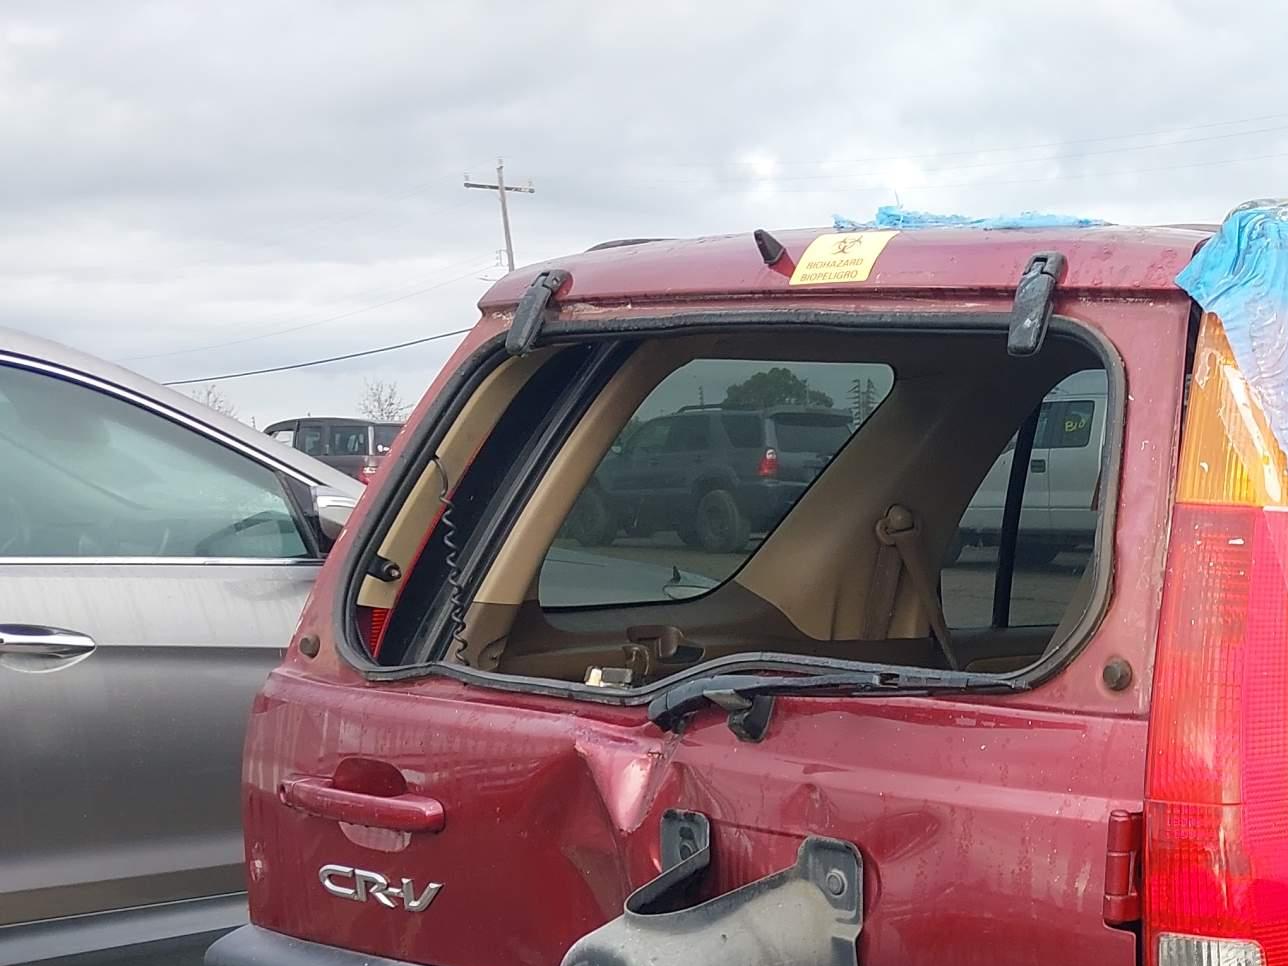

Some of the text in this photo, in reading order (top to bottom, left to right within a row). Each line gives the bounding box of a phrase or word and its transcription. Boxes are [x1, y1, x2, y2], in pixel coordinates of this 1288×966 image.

[806, 258, 864, 270] BIOHAZARD
[800, 270, 858, 282] BIOPELIGRO
[318, 864, 444, 912] CR-V
